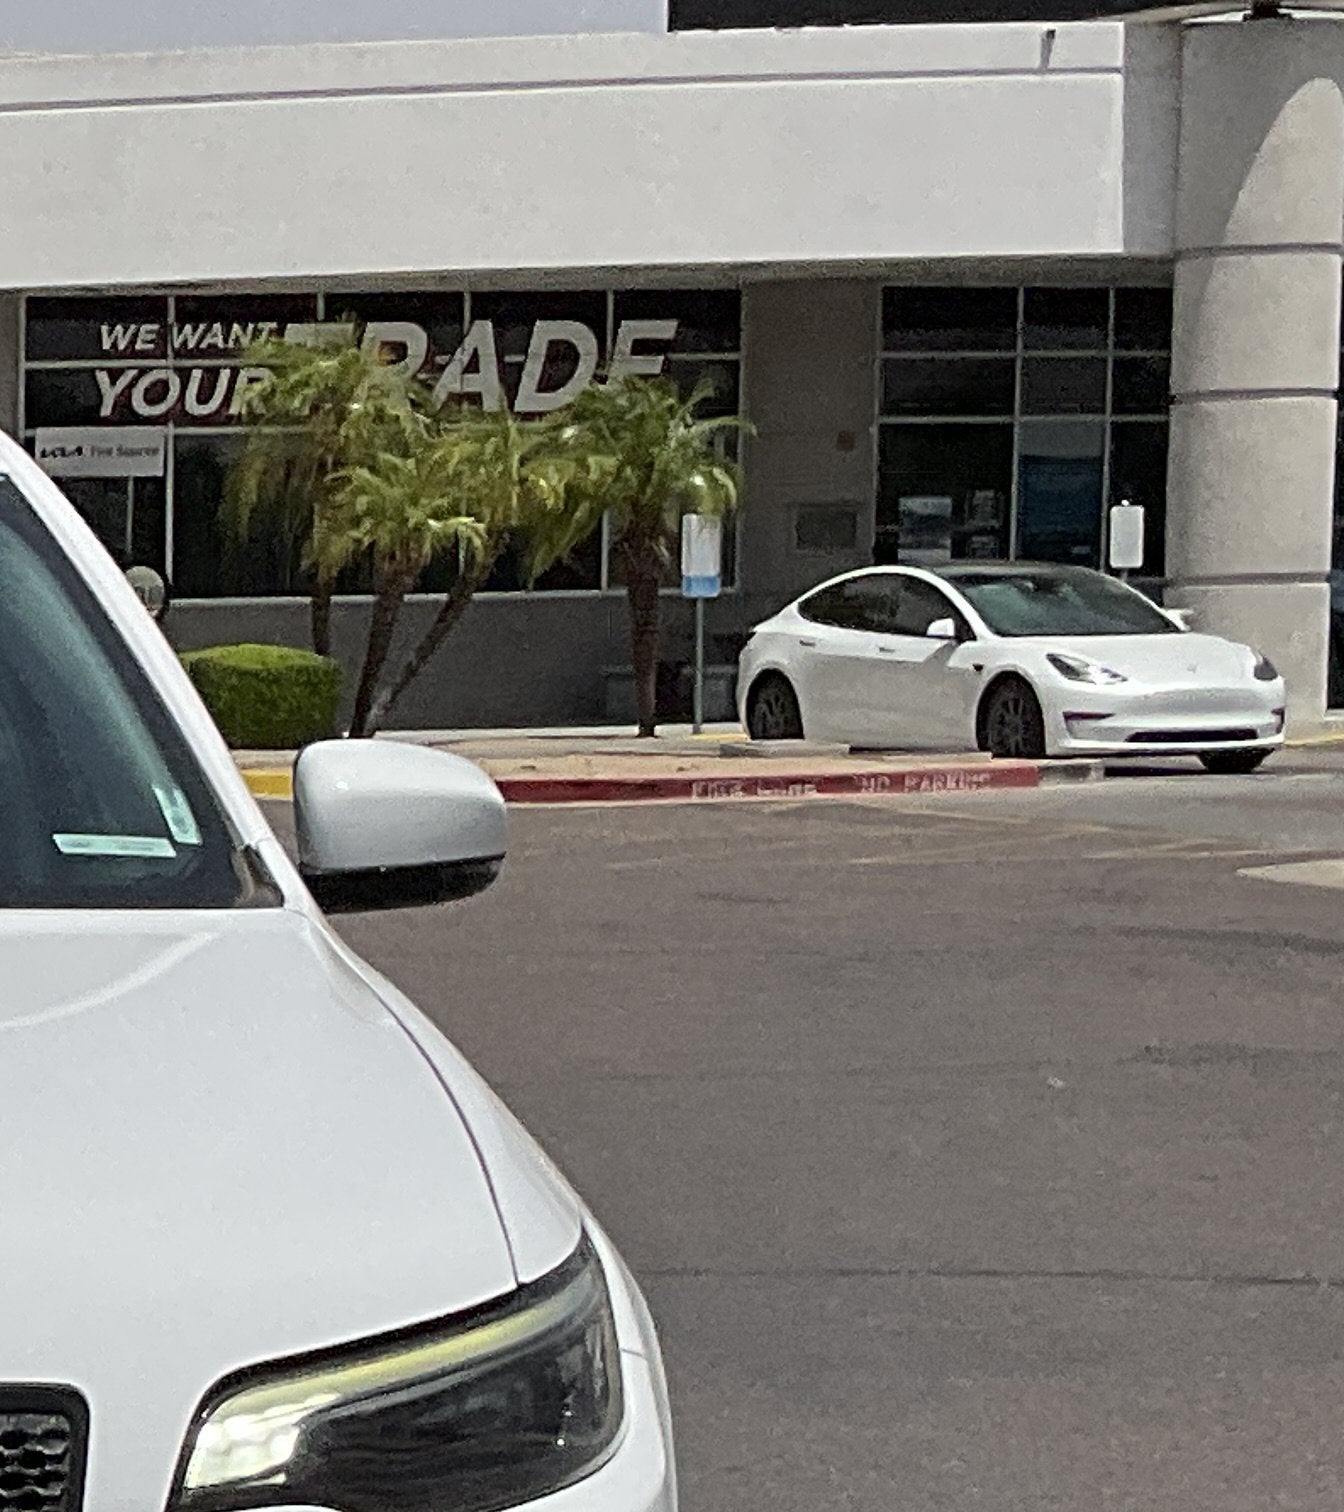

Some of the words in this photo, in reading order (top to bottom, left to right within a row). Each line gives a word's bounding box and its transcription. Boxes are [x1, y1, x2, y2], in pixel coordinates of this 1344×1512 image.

[99, 322, 161, 350] WE
[173, 320, 279, 349] WANT
[94, 366, 278, 418] YOUR
